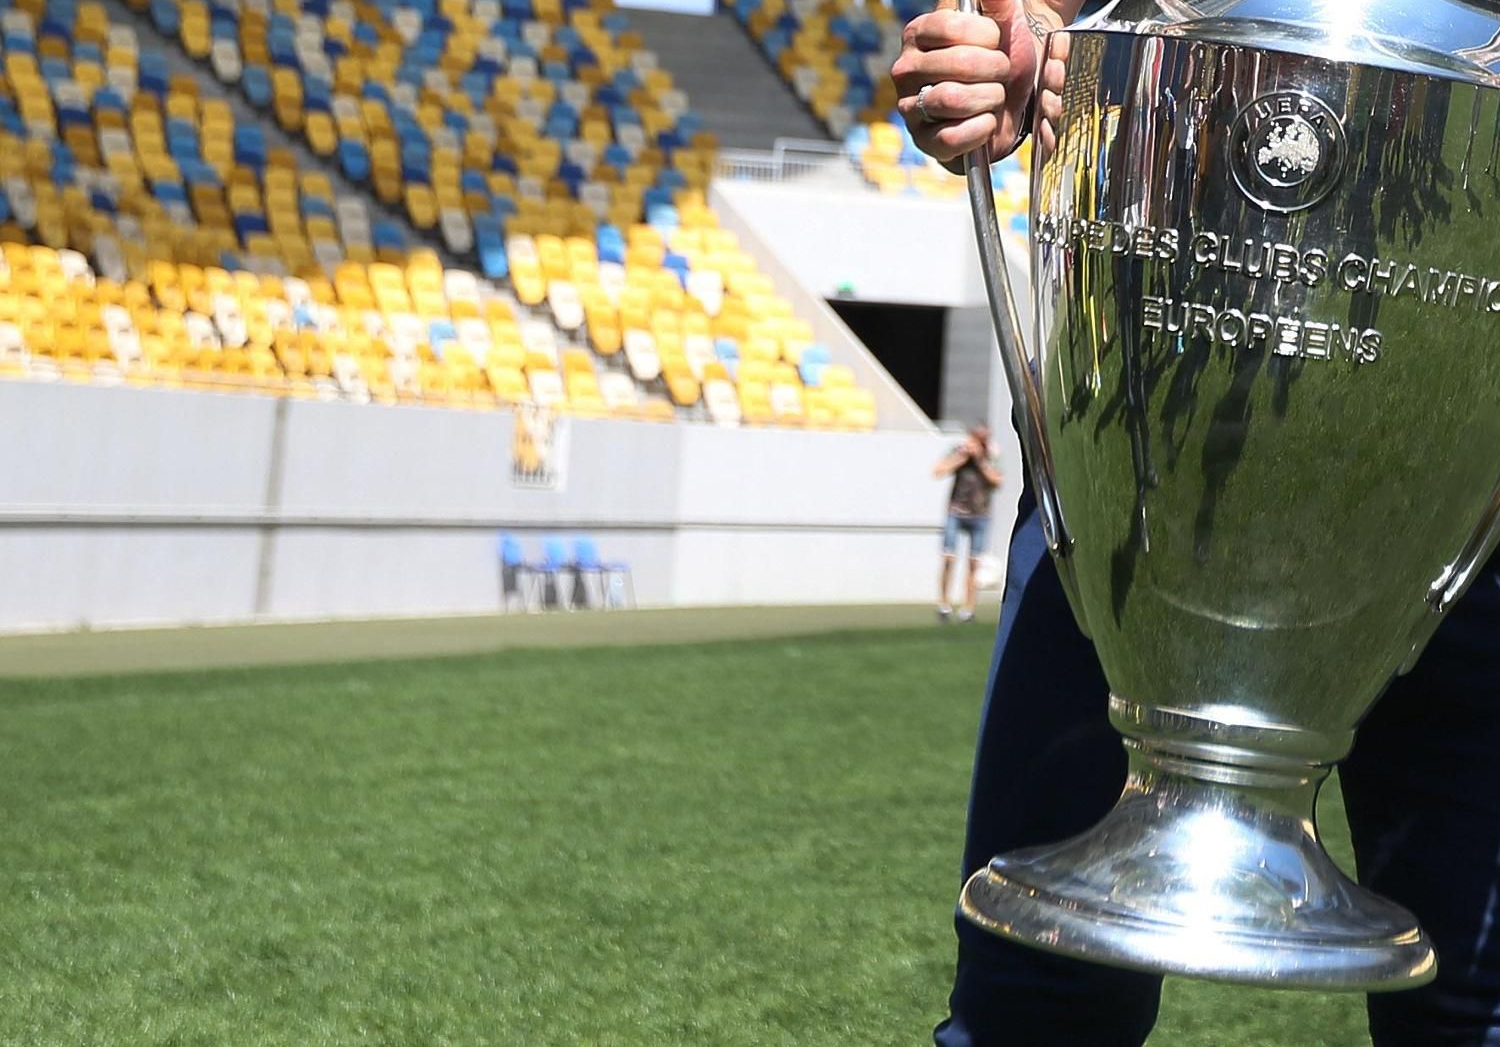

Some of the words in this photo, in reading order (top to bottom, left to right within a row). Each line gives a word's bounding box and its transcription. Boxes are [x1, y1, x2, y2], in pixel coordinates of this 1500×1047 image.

[1254, 96, 1328, 130] UEFA
[1111, 221, 1180, 263] DES
[1189, 231, 1329, 287] CLUBS
